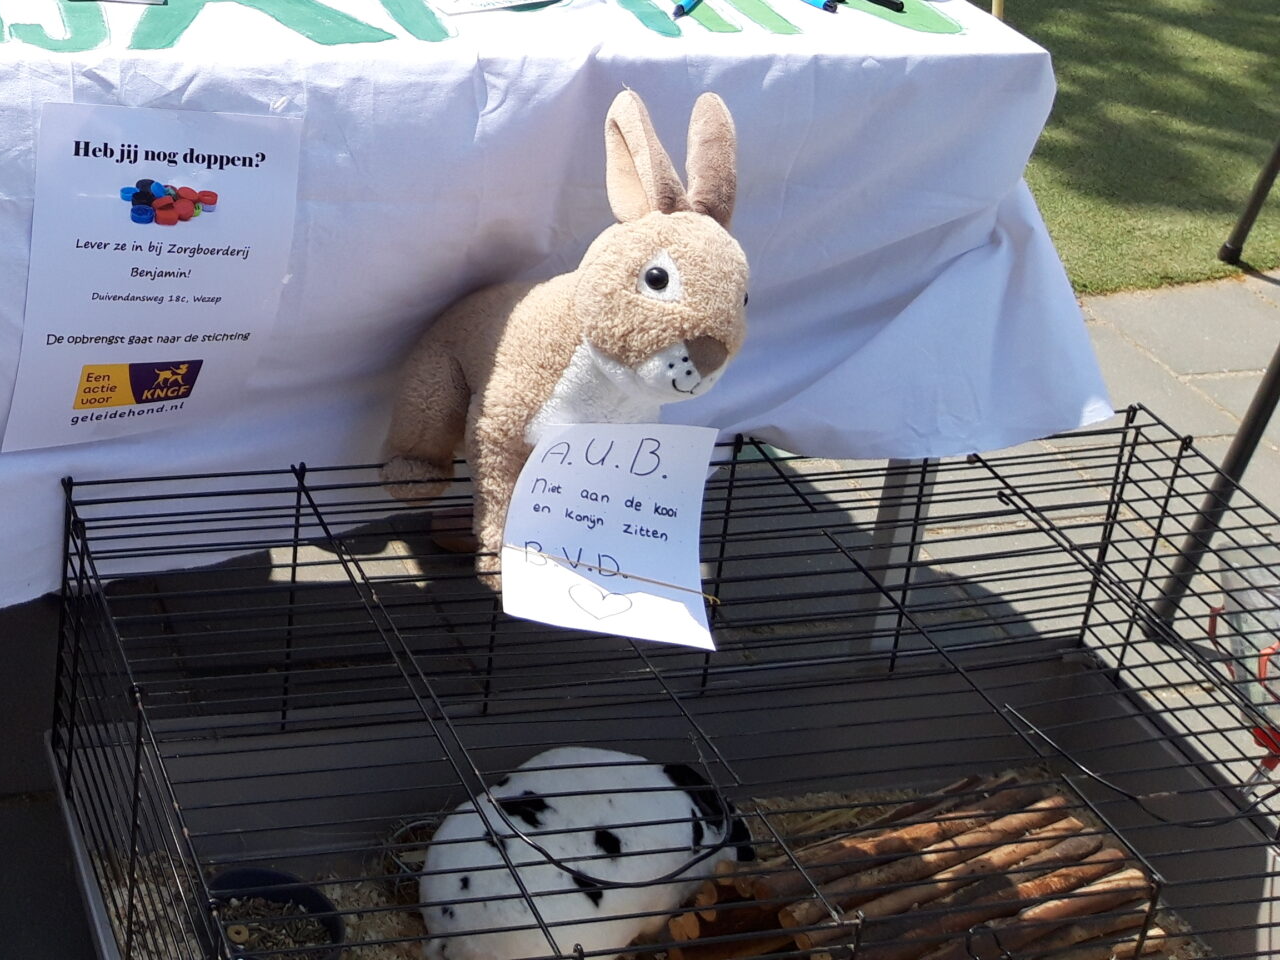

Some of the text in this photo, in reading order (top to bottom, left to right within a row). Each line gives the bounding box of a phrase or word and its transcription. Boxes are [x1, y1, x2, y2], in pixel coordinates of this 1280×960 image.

[73, 140, 266, 170] Heb jij nog doppen?
[76, 239, 251, 260] Lever ze in bij Zorgboerderij
[130, 267, 191, 281] Benjamin!
[91, 292, 164, 304] Duivendansweg
[192, 295, 222, 305] Wezep
[46, 331, 251, 346] De opbrengst gaat naar de stichting
[86, 372, 110, 382] Een
[83, 384, 117, 394] actie
[142, 385, 190, 400] KNGF
[81, 396, 112, 405] voor
[70, 401, 185, 426] geleidehond.nl
[533, 503, 551, 514] en
[580, 489, 610, 503] aan
[624, 496, 642, 512] de
[653, 501, 678, 518] kooi
